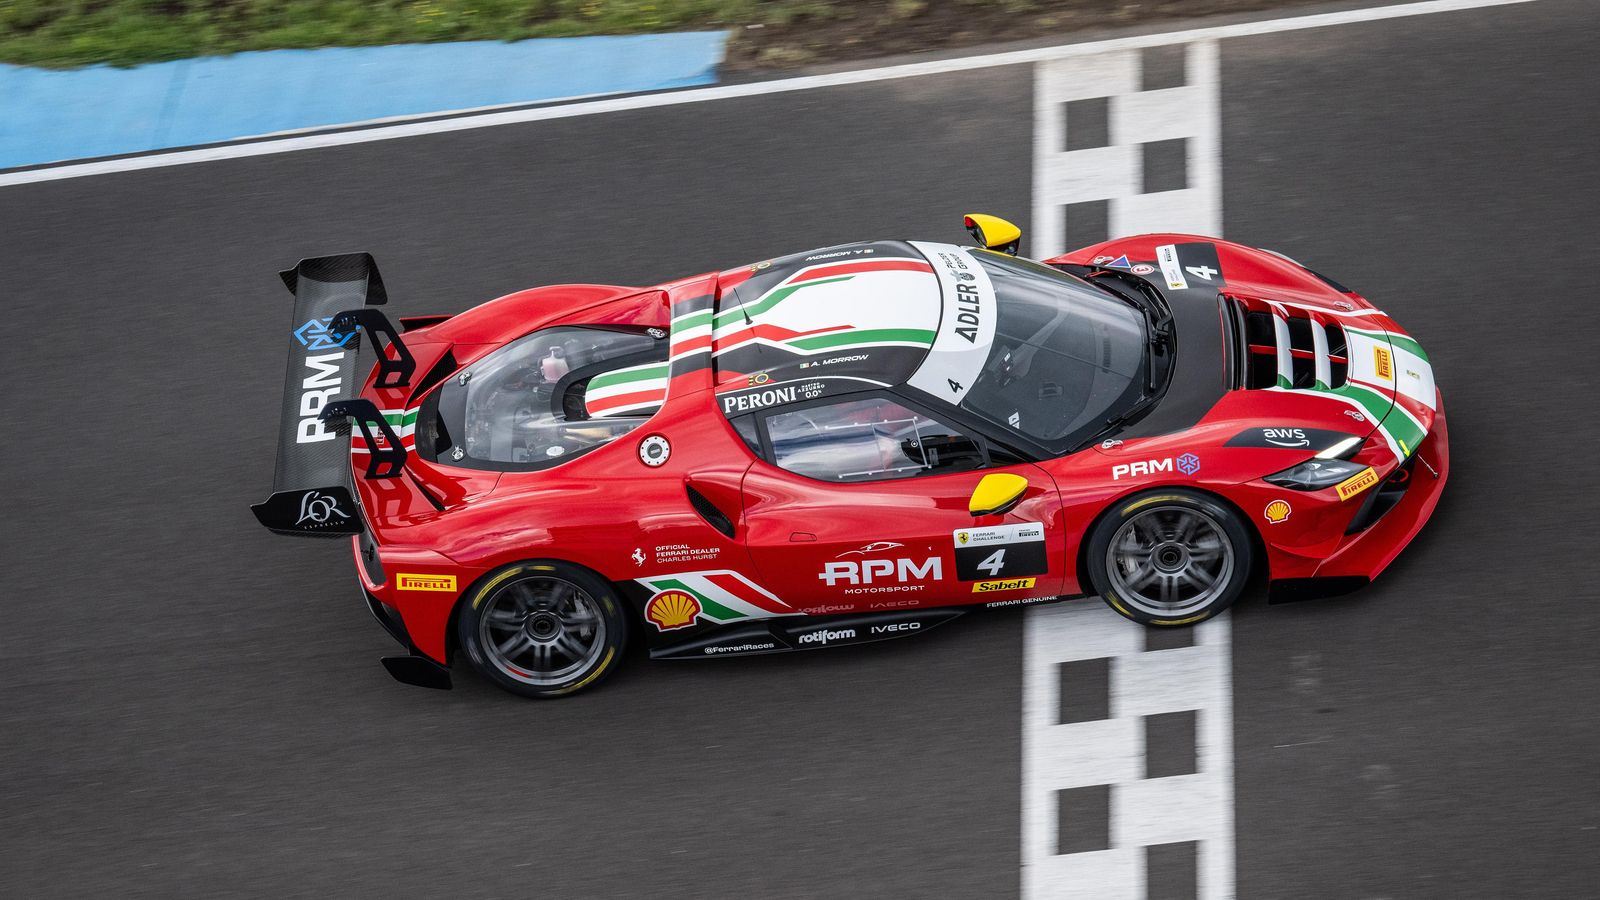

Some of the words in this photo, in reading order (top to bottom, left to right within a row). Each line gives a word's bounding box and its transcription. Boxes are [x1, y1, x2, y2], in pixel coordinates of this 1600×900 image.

[1185, 265, 1218, 280] 4
[954, 283, 980, 344] ADLER
[822, 354, 869, 365] MORROW
[1376, 348, 1389, 378] PIRELLI
[947, 378, 963, 393] 4
[296, 352, 344, 444] PRM
[723, 386, 797, 414] PERONI
[1263, 428, 1306, 439] aws
[1112, 458, 1173, 480] PRM
[1341, 471, 1375, 496] PIRELLI
[304, 520, 345, 530] ESPRESSO
[655, 544, 690, 552] OFFICIAL
[656, 549, 689, 558] FERRARI
[690, 547, 721, 555] DEALER
[657, 555, 691, 563] CHARLES
[693, 553, 717, 561] HURST
[976, 548, 1006, 576] 4
[818, 556, 943, 587] RPM
[401, 577, 451, 589] PIRELLI
[979, 579, 1029, 592] Sabelt
[844, 585, 925, 595] MOTORSPORT
[986, 599, 1021, 608] FERRARI
[1021, 595, 1058, 604] GENUINE
[871, 622, 921, 634] IVECO
[798, 629, 856, 645] rotiform
[704, 642, 775, 654] @FerrariRaces
